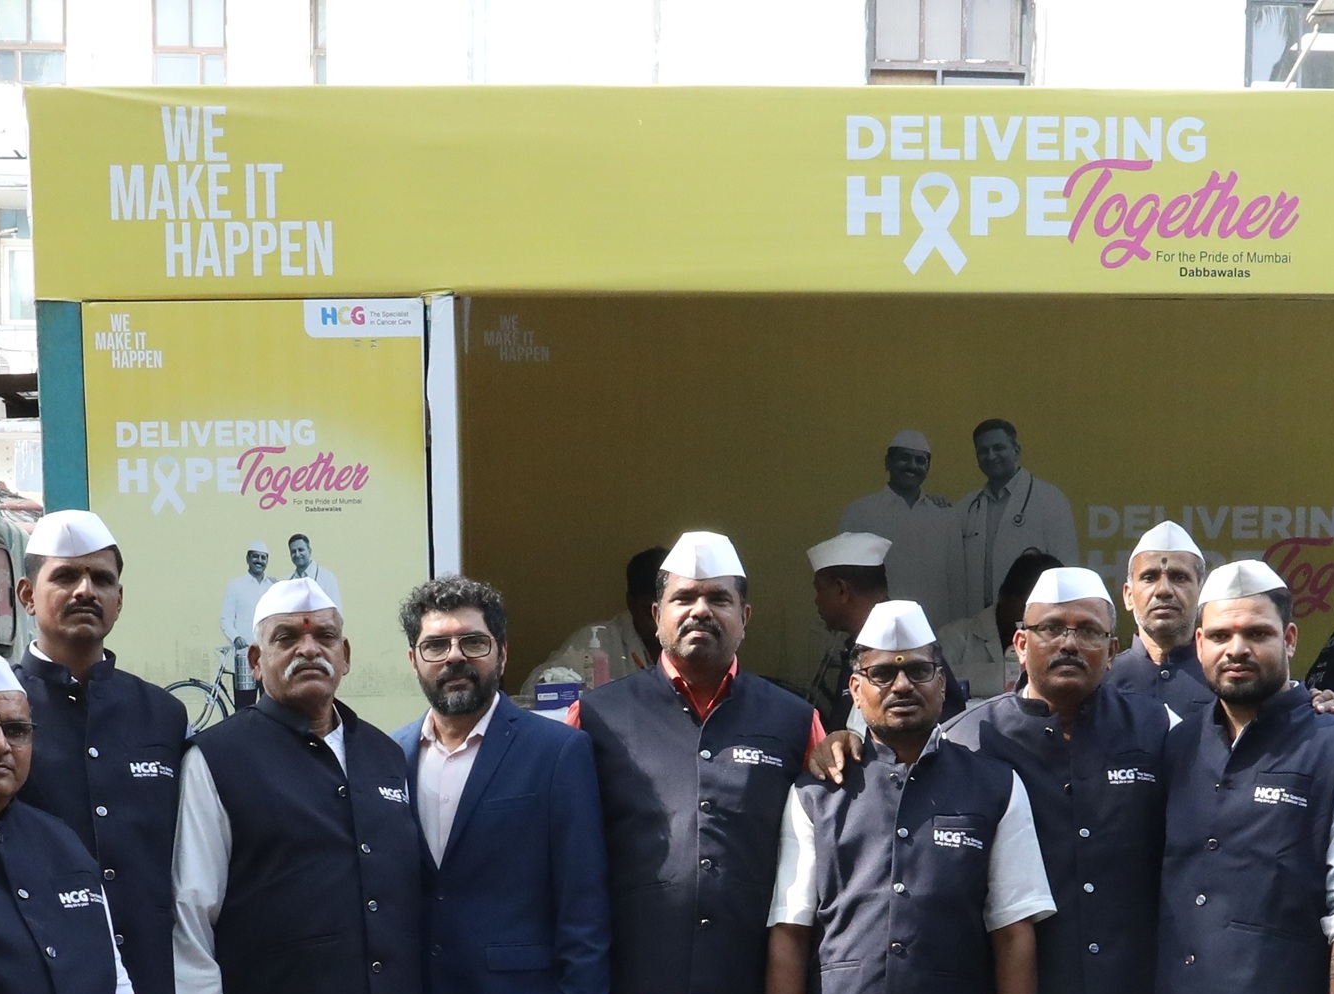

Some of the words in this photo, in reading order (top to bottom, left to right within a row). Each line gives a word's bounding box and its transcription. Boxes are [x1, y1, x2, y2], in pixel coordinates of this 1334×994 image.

[161, 105, 227, 162] WE
[846, 114, 1207, 163] DELIVERING
[109, 163, 232, 220] MAKE
[245, 163, 283, 219] IT
[1062, 159, 1299, 269] Together
[165, 220, 334, 278] HAPPEN
[1156, 250, 1175, 262] For
[1178, 251, 1196, 263] the
[1200, 251, 1229, 263] Pride
[1232, 251, 1244, 263] of
[1247, 252, 1291, 263] Mumbai
[1179, 266, 1251, 278] Dabbawalas
[110, 313, 130, 332] WE
[321, 306, 365, 325] HCG
[499, 315, 519, 330] WE
[95, 332, 131, 350] MAKE
[134, 332, 146, 349] IT
[483, 330, 521, 346] MAKE
[523, 330, 534, 346] IT
[111, 350, 163, 368] HAPPEN
[500, 346, 549, 361] HAPPEN
[115, 419, 316, 447] DELIVERING
[236, 446, 369, 510] Together
[732, 748, 760, 760] HCG
[129, 762, 158, 773] HCG
[1107, 769, 1135, 780] HCG
[1254, 786, 1281, 800] HCG
[933, 829, 961, 844] HCG
[58, 889, 89, 904] HCG
